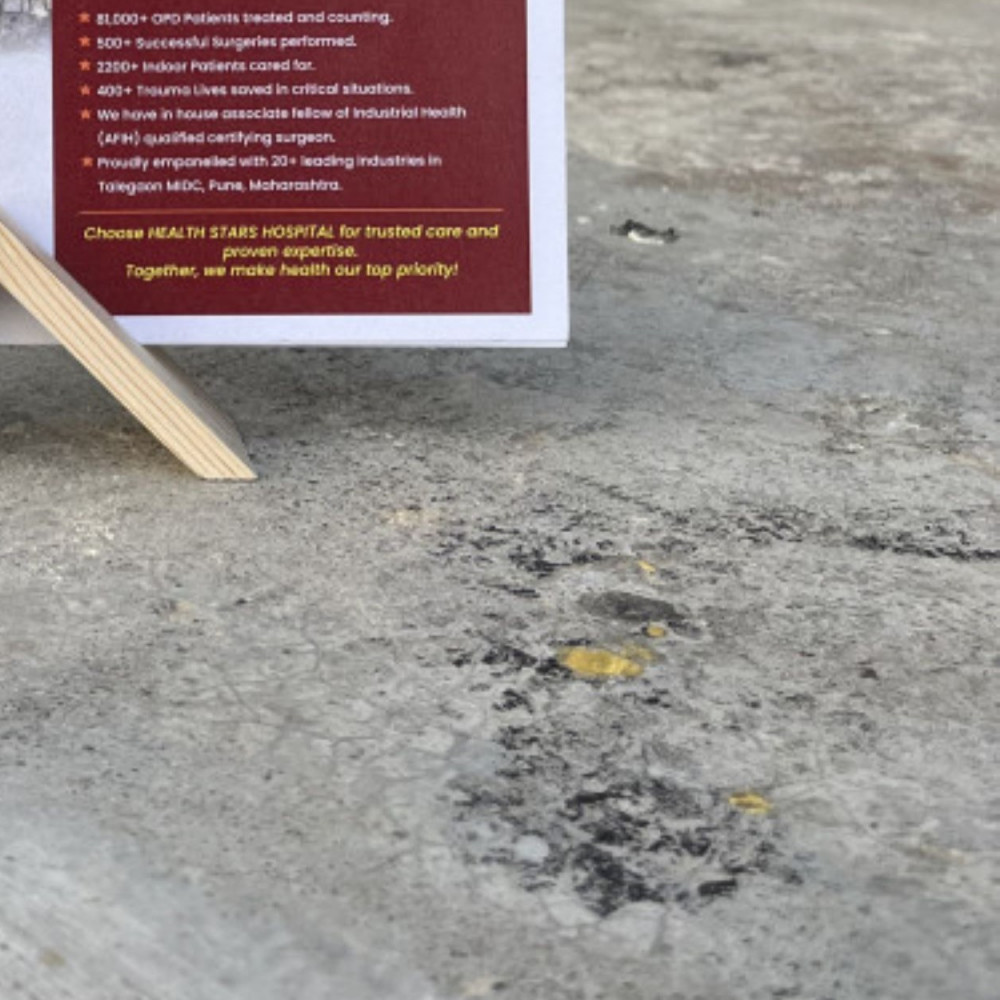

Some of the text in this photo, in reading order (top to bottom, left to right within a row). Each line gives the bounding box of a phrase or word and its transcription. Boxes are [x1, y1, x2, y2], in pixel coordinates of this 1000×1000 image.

[151, 13, 181, 25] OPD
[183, 12, 240, 25] Patients
[242, 11, 294, 24] treated
[296, 11, 325, 24] and
[326, 11, 394, 26] counting.
[96, 34, 358, 52] 500+ Successful Surgeries performed.
[142, 60, 188, 74] Indoor
[190, 60, 247, 73] Patients
[248, 58, 291, 73] cared
[96, 82, 414, 97] 400+ Trauma Lives saved in critical situations.
[97, 109, 120, 121] We
[122, 109, 157, 121] have
[162, 108, 173, 120] in
[176, 108, 219, 120] house
[222, 107, 289, 120] associate
[291, 106, 333, 119] fellow
[335, 106, 350, 119] of
[420, 106, 467, 119] Health
[142, 131, 205, 147] qualified
[206, 130, 273, 148] certifying
[275, 132, 336, 148] surgeon.
[97, 156, 149, 172] Proudly
[238, 155, 269, 167] with
[271, 154, 297, 167] 20+
[300, 154, 355, 170] leading
[427, 154, 443, 167] in
[98, 178, 343, 196] Talegaon MIDC, Pune, Maharashtra.
[83, 224, 500, 240] Choose HEALTH STARS HOSPITAL for trusted care and
[222, 243, 358, 263] proven expertise.
[126, 261, 460, 281] Together, we make health our top priority!
